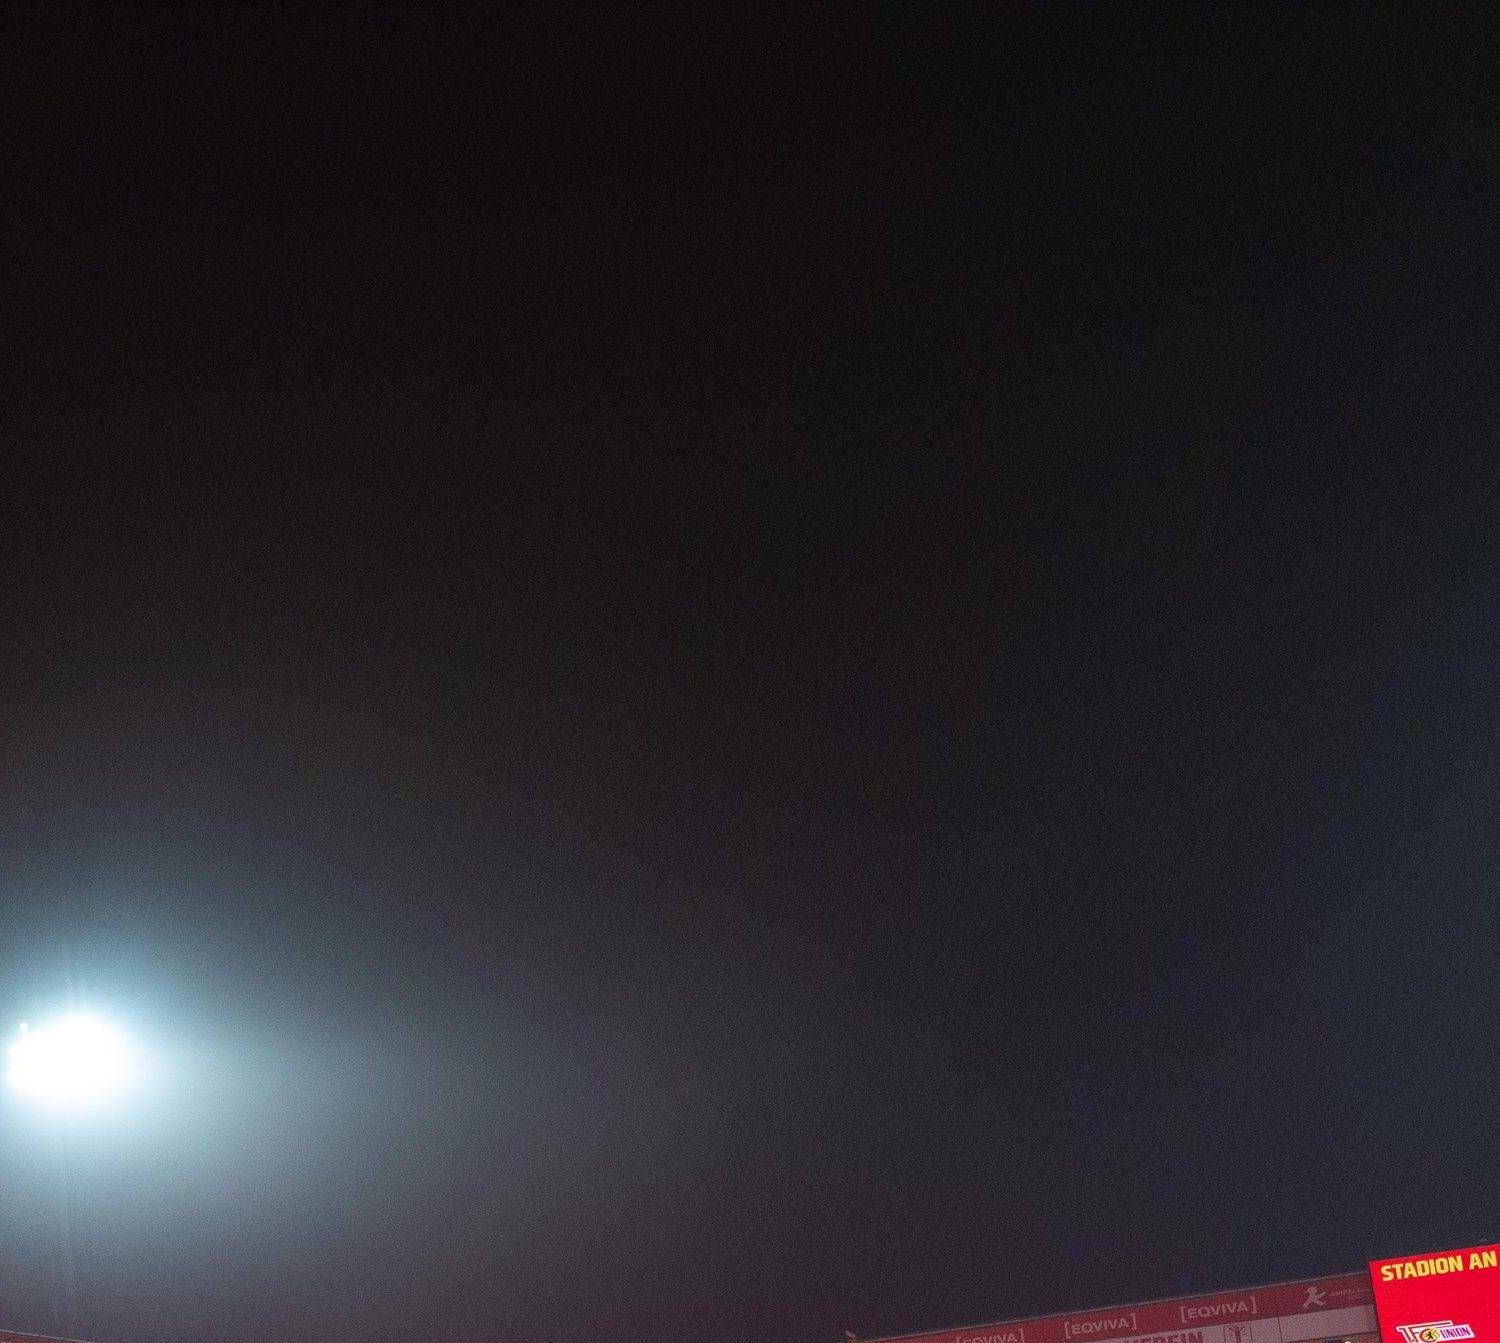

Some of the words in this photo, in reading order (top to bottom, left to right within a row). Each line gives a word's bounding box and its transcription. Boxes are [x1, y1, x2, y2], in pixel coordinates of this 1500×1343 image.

[1380, 1255, 1464, 1282] STADION
[1468, 1250, 1498, 1271] AN
[1440, 1327, 1471, 1339] UNION
